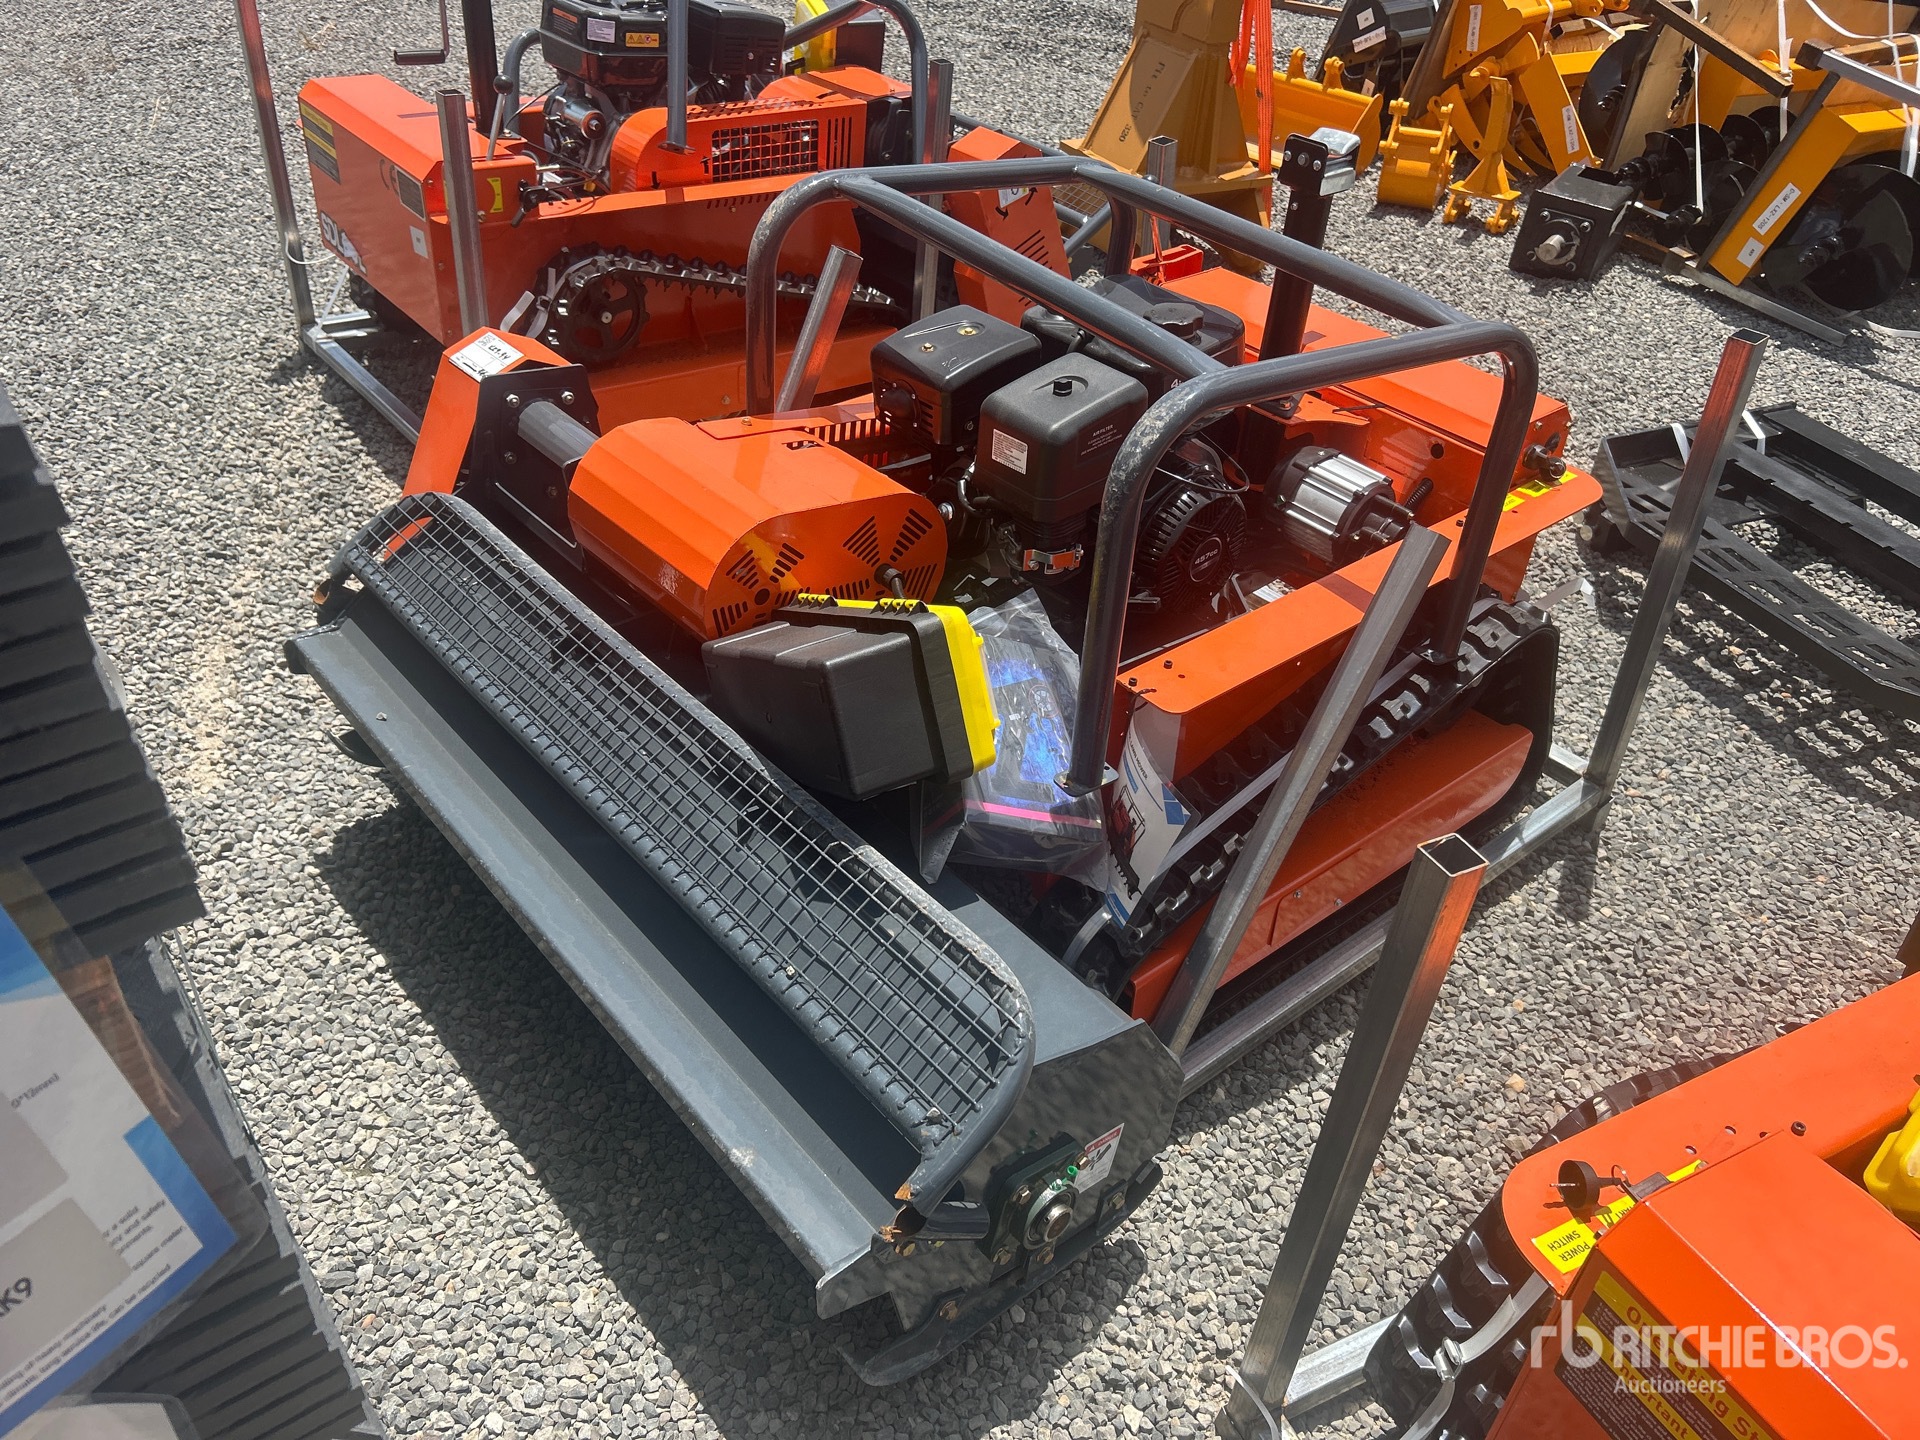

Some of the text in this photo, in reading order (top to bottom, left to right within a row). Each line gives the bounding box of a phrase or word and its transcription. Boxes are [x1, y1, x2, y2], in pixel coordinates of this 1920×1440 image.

[1118, 123, 1132, 142] 320
[1136, 757, 1149, 780] MOWER
[1547, 1230, 1582, 1252] SWITCH
[1558, 1241, 1591, 1262] POWER
[0, 1276, 33, 1319] K9
[1626, 1306, 1730, 1419] Operating
[1608, 1348, 1690, 1440] Important
